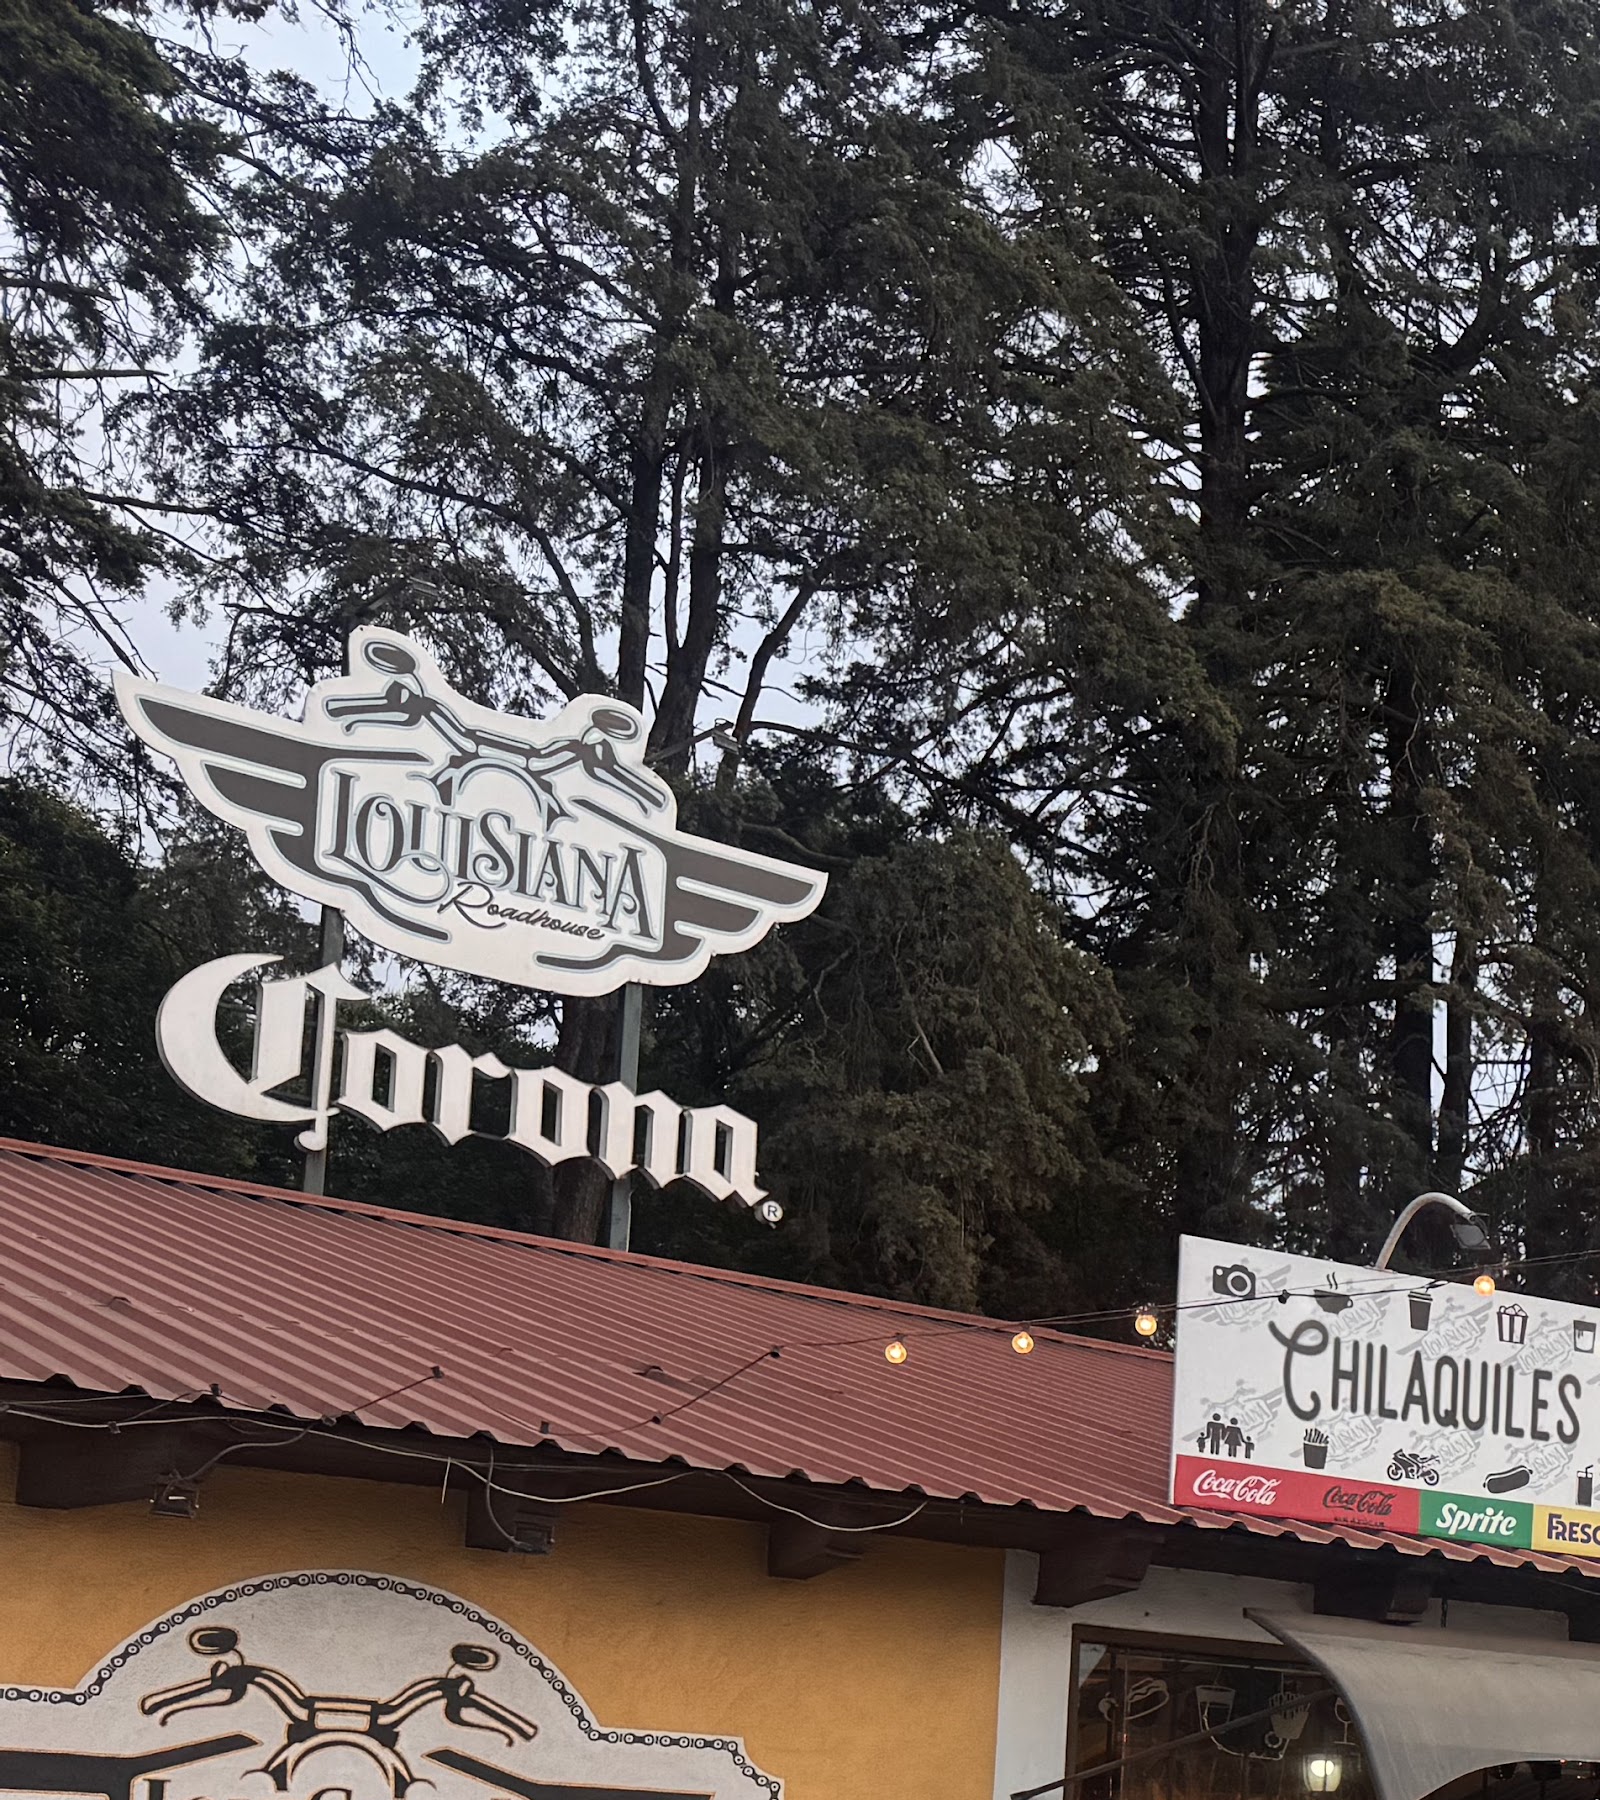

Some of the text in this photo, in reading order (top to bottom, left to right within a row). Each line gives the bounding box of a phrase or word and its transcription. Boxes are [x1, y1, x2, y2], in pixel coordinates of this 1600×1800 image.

[328, 774, 656, 941] LOUISIANA
[438, 882, 608, 943] Roadhouse
[156, 953, 770, 1203] Corona
[1268, 1320, 1581, 1444] CHILAQUILES
[1193, 1469, 1282, 1506] Coca-Cola
[1322, 1485, 1398, 1517] Coca-Cola
[1436, 1502, 1518, 1536] Sprite
